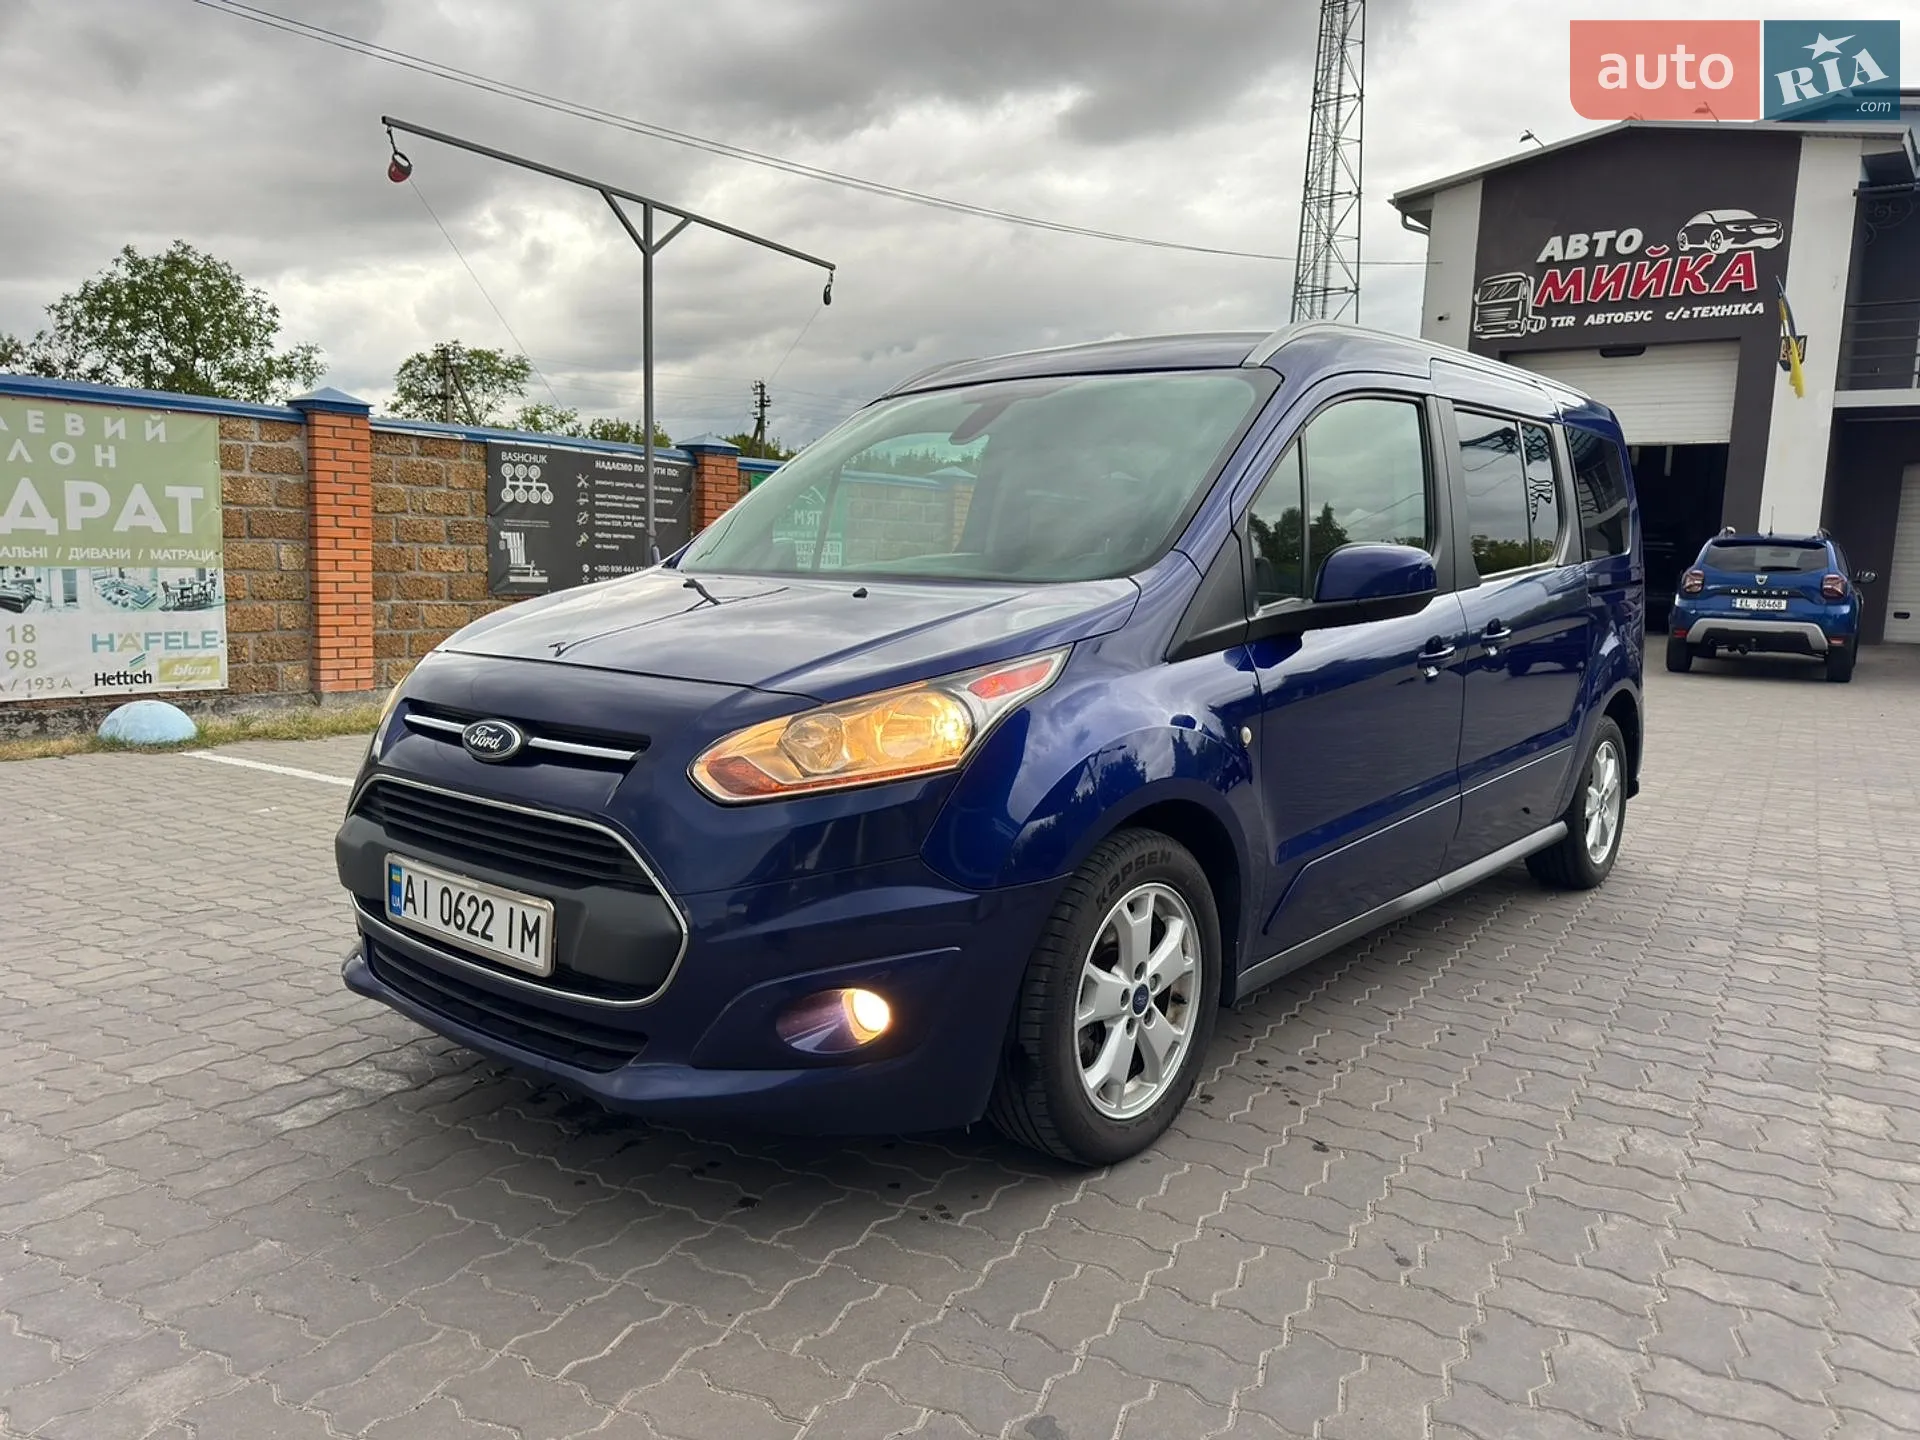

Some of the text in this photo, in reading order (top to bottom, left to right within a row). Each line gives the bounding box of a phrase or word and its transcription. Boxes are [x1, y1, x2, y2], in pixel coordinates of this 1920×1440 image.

[1536, 228, 1643, 262] АВТО
[1532, 244, 1758, 308] МИЙКА
[1551, 315, 1576, 328] TIR
[1584, 310, 1653, 326] АВТОБУС
[501, 451, 548, 464] BASHCHUK
[68, 547, 132, 561] ДИВАНИ
[150, 549, 215, 563] МАТРАЦИ
[6, 624, 37, 644] 18
[92, 630, 219, 653] HÄFELE
[5, 649, 37, 669] 98
[25, 677, 55, 691] 193
[94, 670, 152, 687] Hettich
[470, 725, 504, 750] Ford
[403, 874, 541, 958] AI 0622 IM
